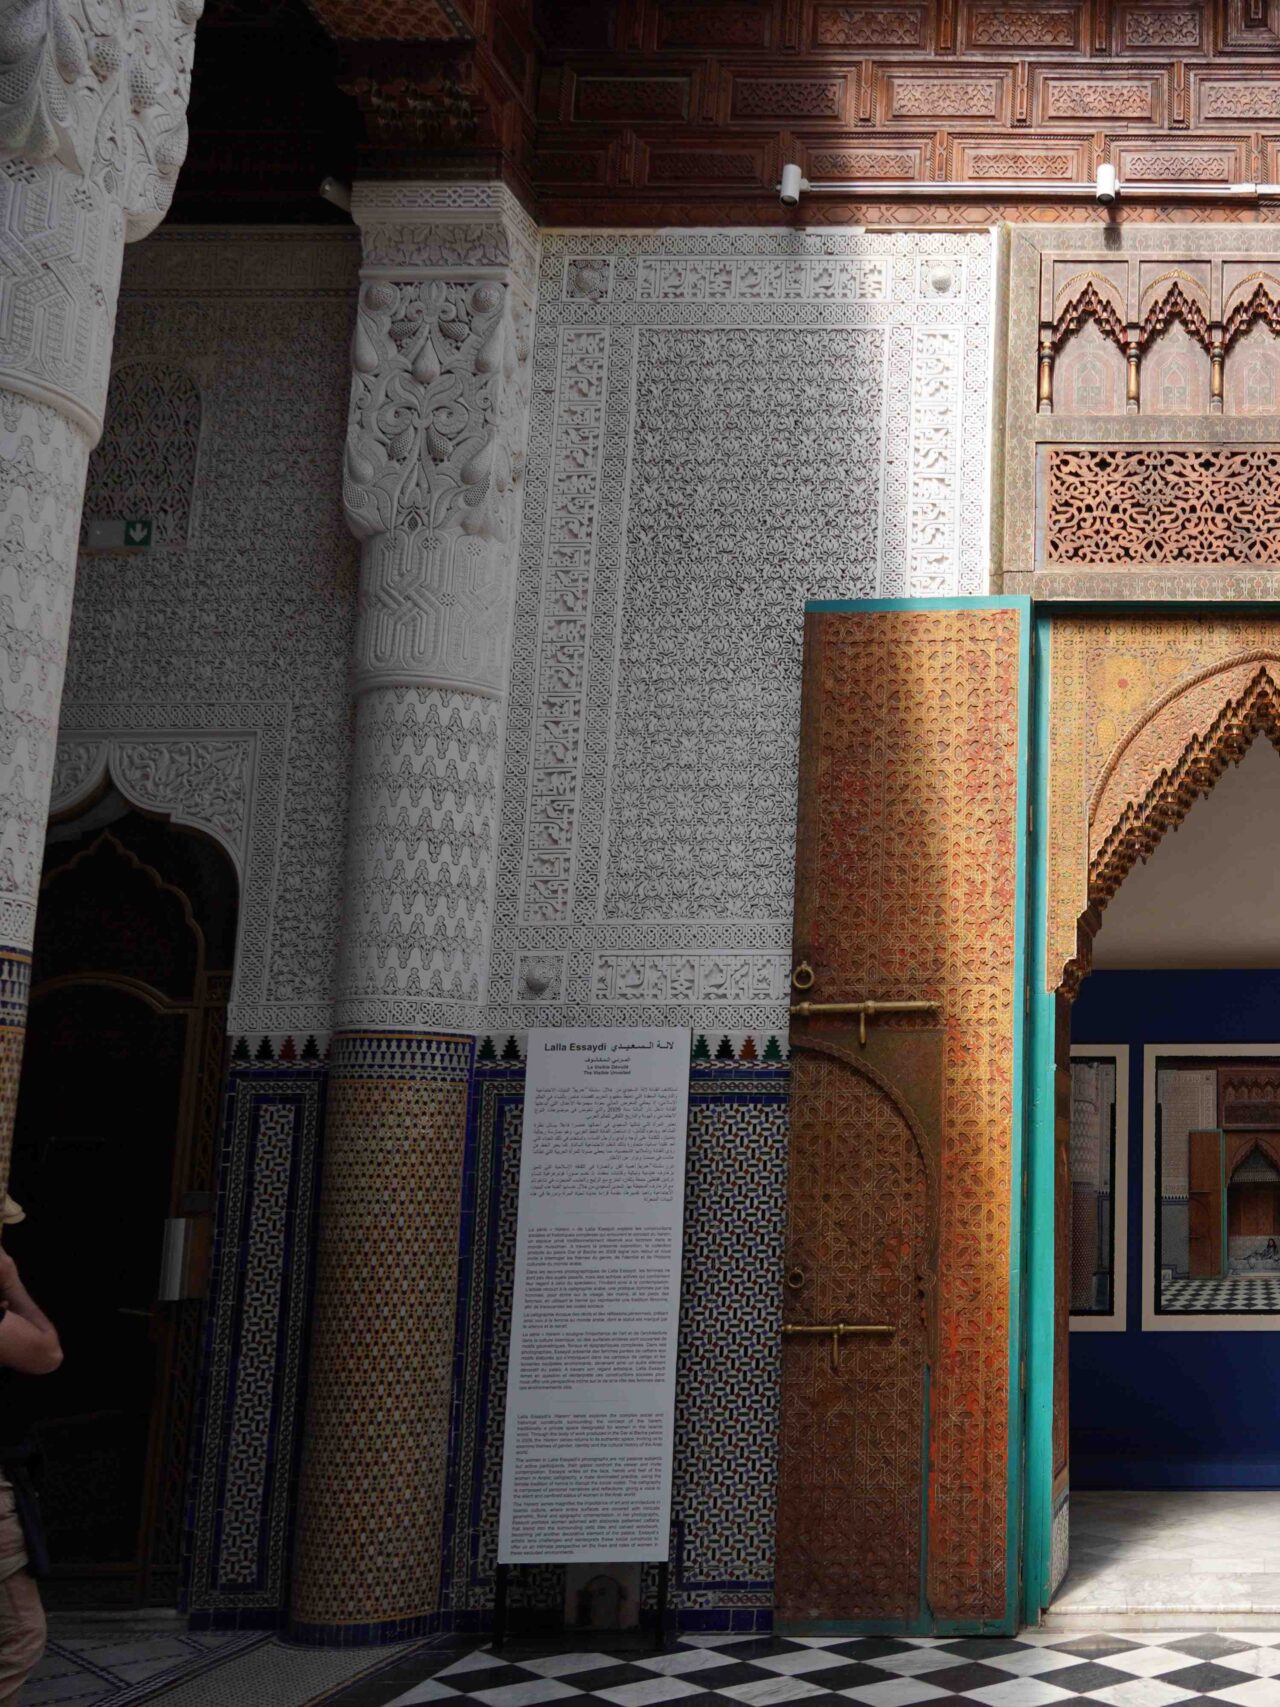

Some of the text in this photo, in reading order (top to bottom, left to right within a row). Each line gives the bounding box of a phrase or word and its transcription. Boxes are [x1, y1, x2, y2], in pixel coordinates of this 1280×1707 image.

[544, 1042, 607, 1053] Lalla Essaydi
[611, 1041, 653, 1052] السعيدي
